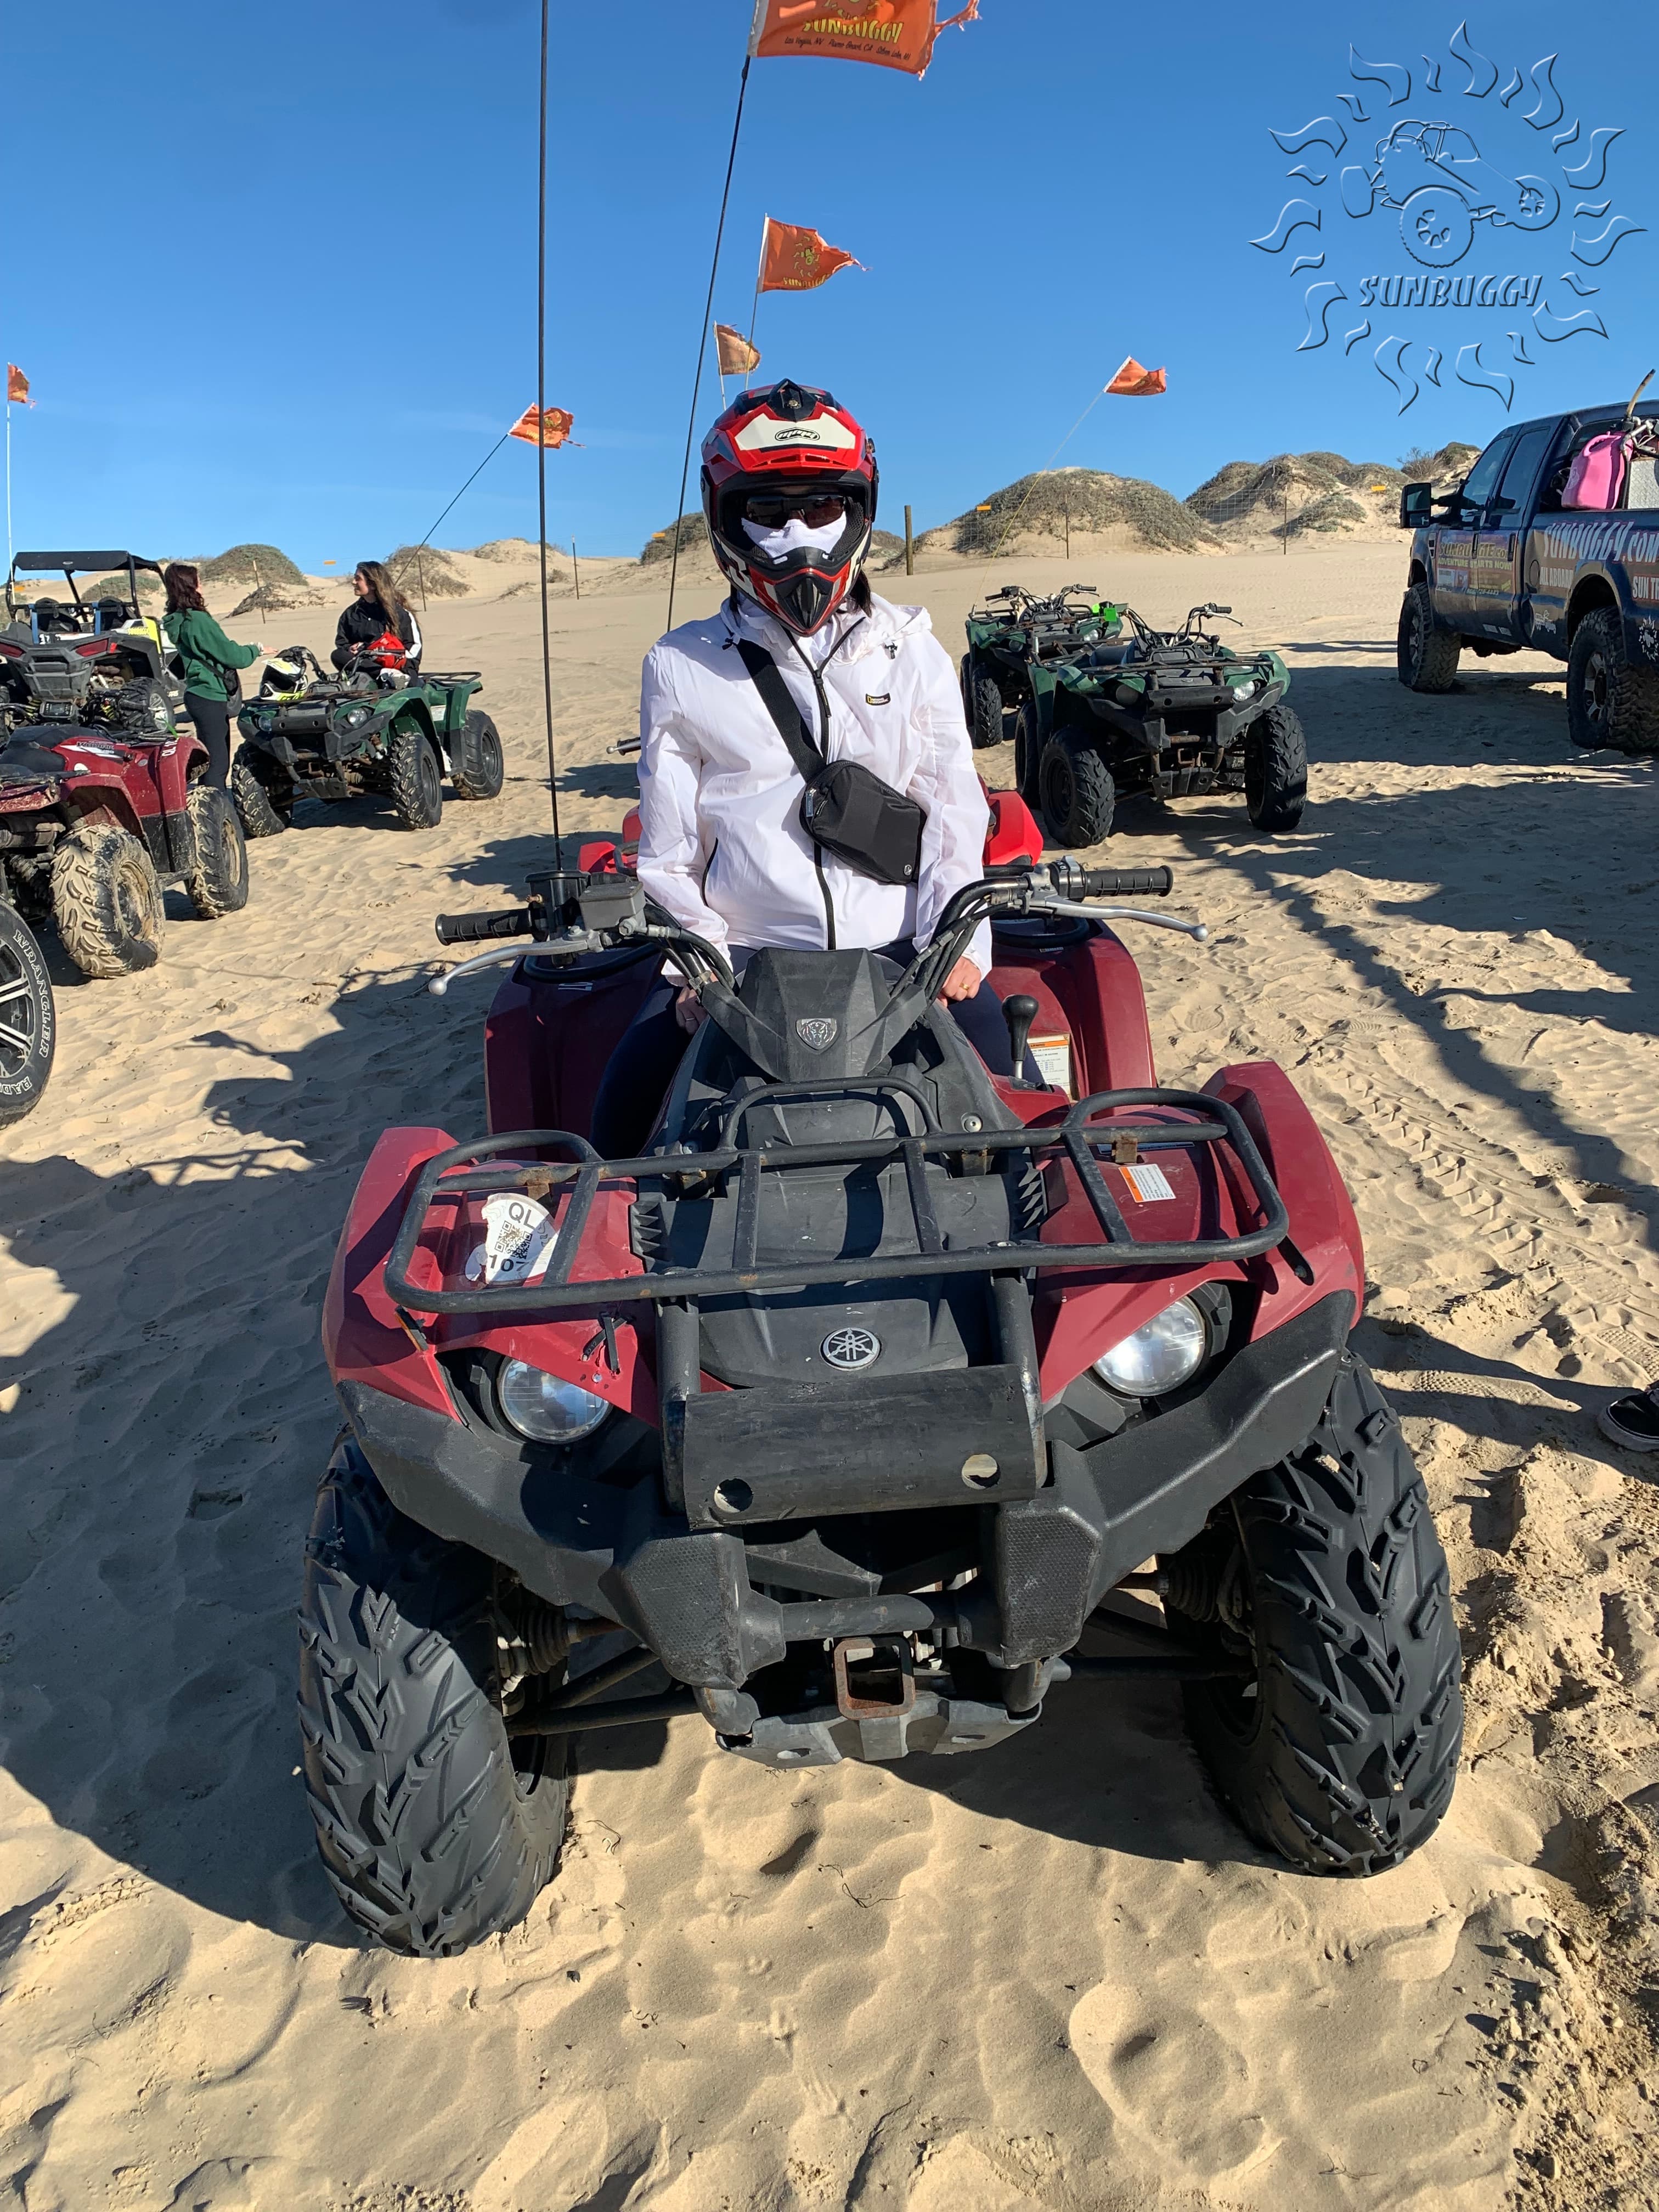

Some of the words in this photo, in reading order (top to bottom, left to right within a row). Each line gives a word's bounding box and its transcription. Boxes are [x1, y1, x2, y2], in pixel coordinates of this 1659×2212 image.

[803, 18, 904, 43] SUNBUGGY
[1438, 557, 1469, 568] ADVENTURE
[1540, 566, 1549, 585] ALL
[1632, 575, 1649, 599] SUN
[13, 929, 51, 1059] WRANGLER
[508, 1201, 536, 1230] QL
[489, 1254, 531, 1272] 107
